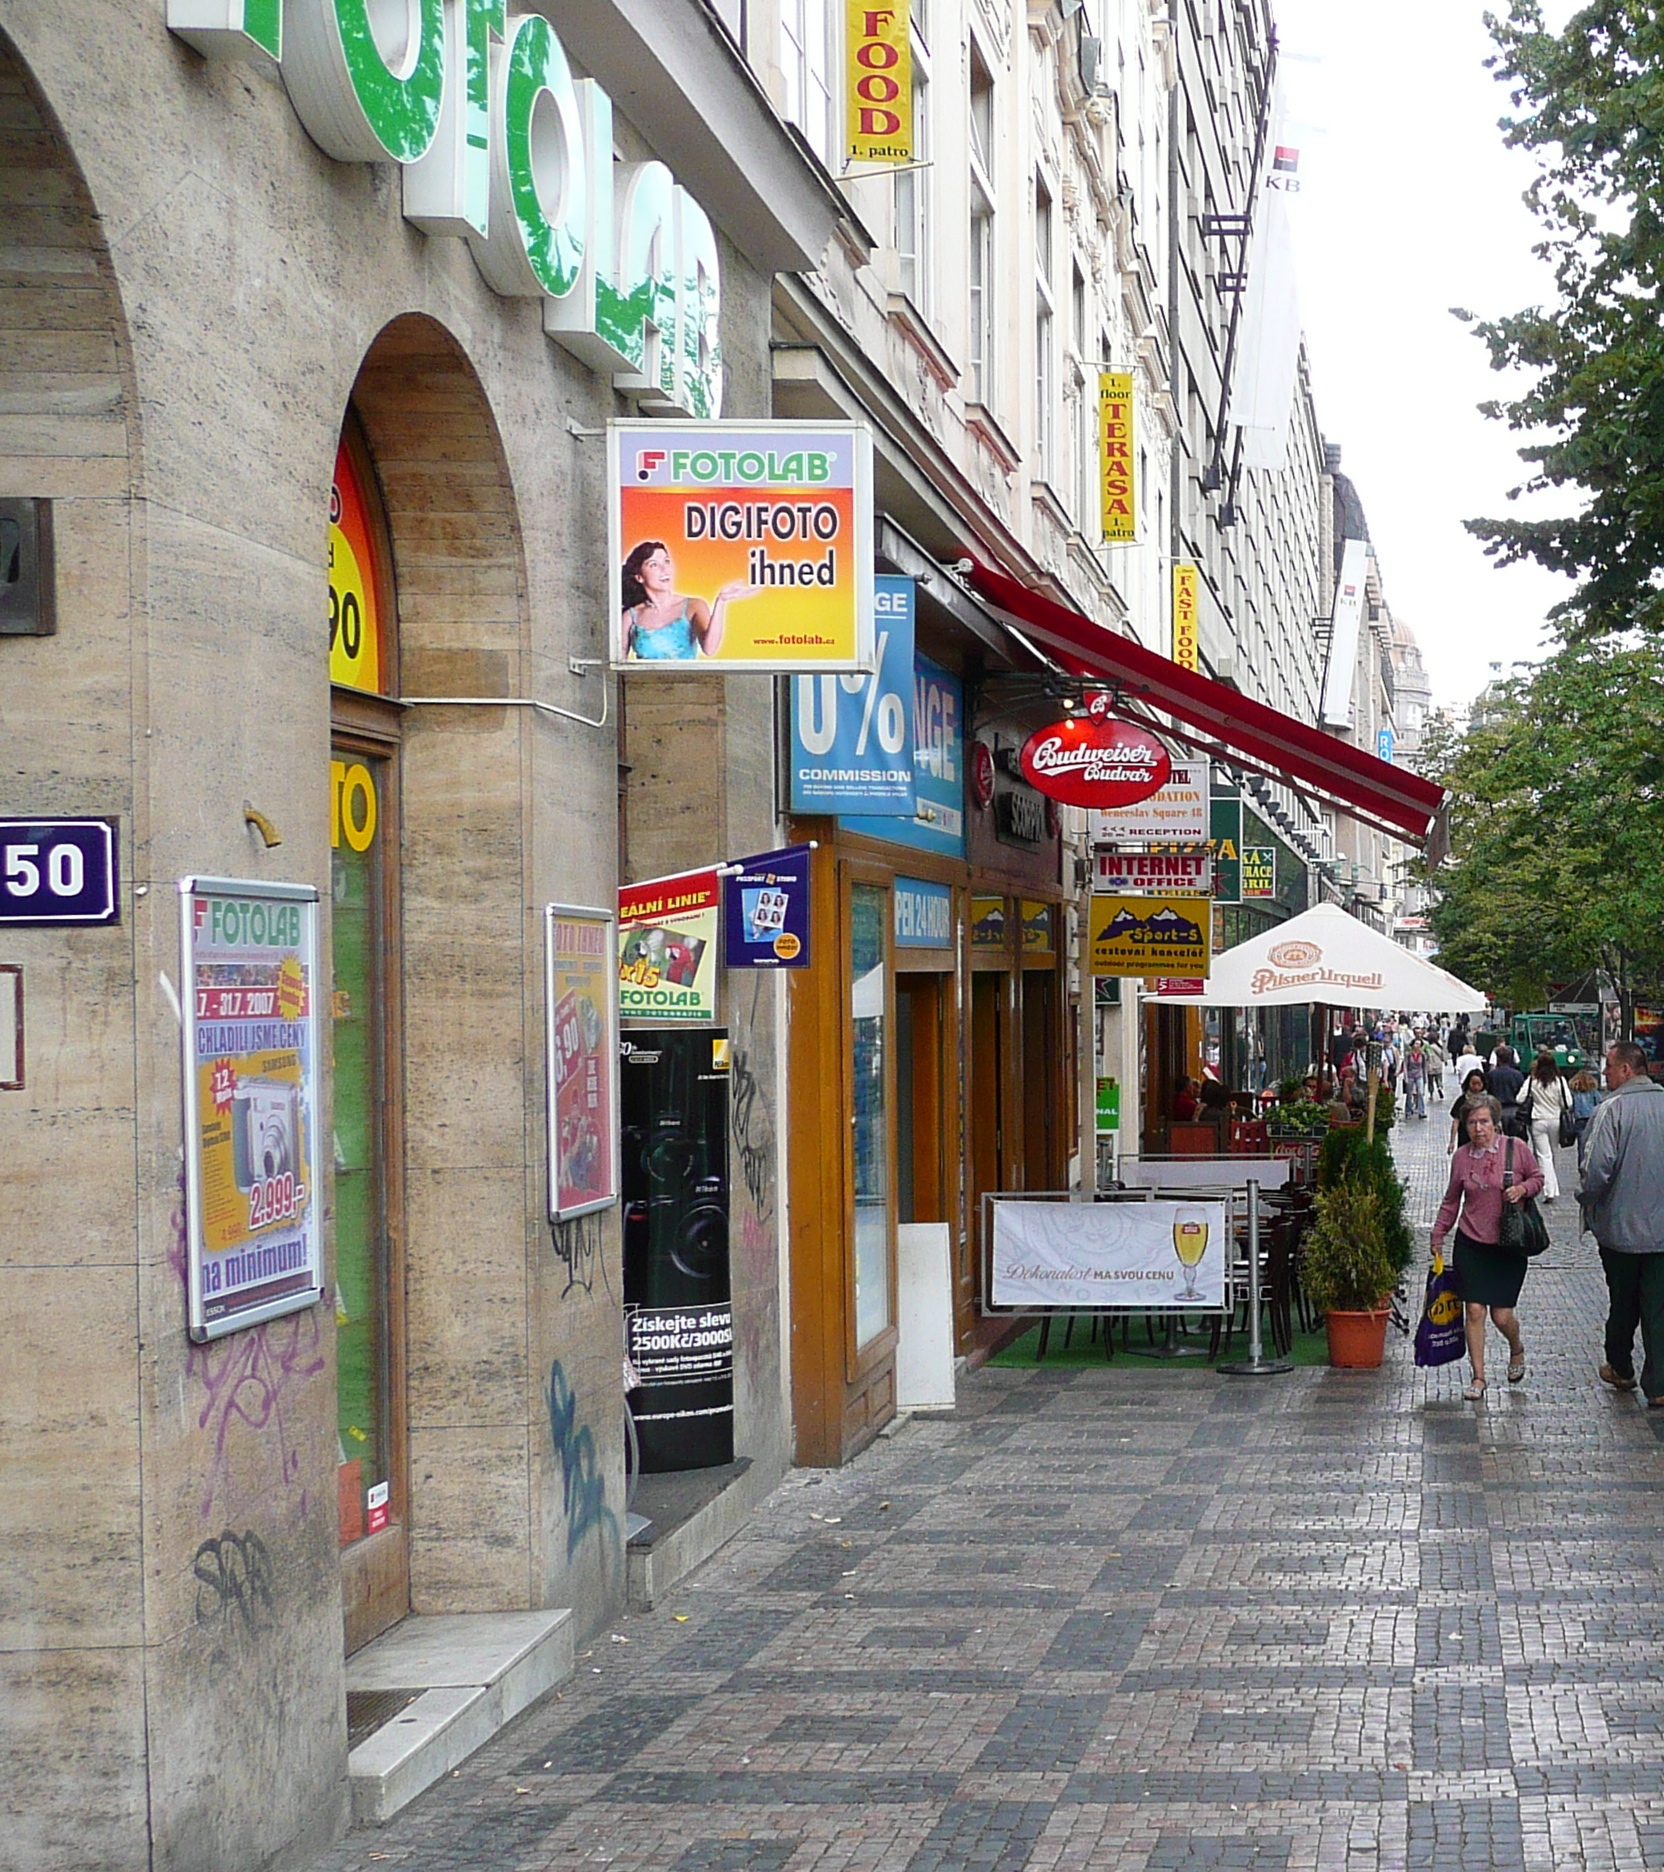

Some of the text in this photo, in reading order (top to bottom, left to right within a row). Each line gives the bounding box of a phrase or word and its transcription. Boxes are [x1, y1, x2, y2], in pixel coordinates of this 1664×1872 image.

[856, 10, 901, 135] FOOD
[852, 145, 909, 158] 1. patro
[1265, 174, 1301, 193] KB
[1100, 389, 1131, 399] floor
[672, 452, 829, 482] FOTOLAB
[1104, 403, 1130, 515] TERASA
[686, 504, 838, 541] DIGIFOTO
[1102, 528, 1135, 538] patro
[749, 548, 836, 587] ihned
[1178, 576, 1193, 620] FAST
[1032, 737, 1154, 769] Budweiser
[799, 768, 912, 783] COMMISSION
[1083, 762, 1154, 782] Budvar
[1153, 808, 1188, 821] Square
[1129, 828, 1202, 836] RECEPTION
[6, 843, 84, 896] 50
[1100, 856, 1206, 876] INTERNET
[1133, 877, 1198, 887] OFFICE
[211, 901, 301, 947] FOTOLAB
[1132, 927, 1199, 943] Sport-S
[1095, 946, 1146, 956] cestovní
[1250, 967, 1319, 995] Pilsner
[1319, 966, 1384, 989] Urquell
[247, 992, 274, 1016] 2007
[620, 991, 701, 1007] FOTOLAB
[202, 1233, 307, 1295] na minimum!
[1002, 1261, 1094, 1282] Dokonalost
[1114, 1269, 1144, 1281] SVOU
[1145, 1269, 1174, 1281] CENU
[632, 1314, 697, 1334] Získejte
